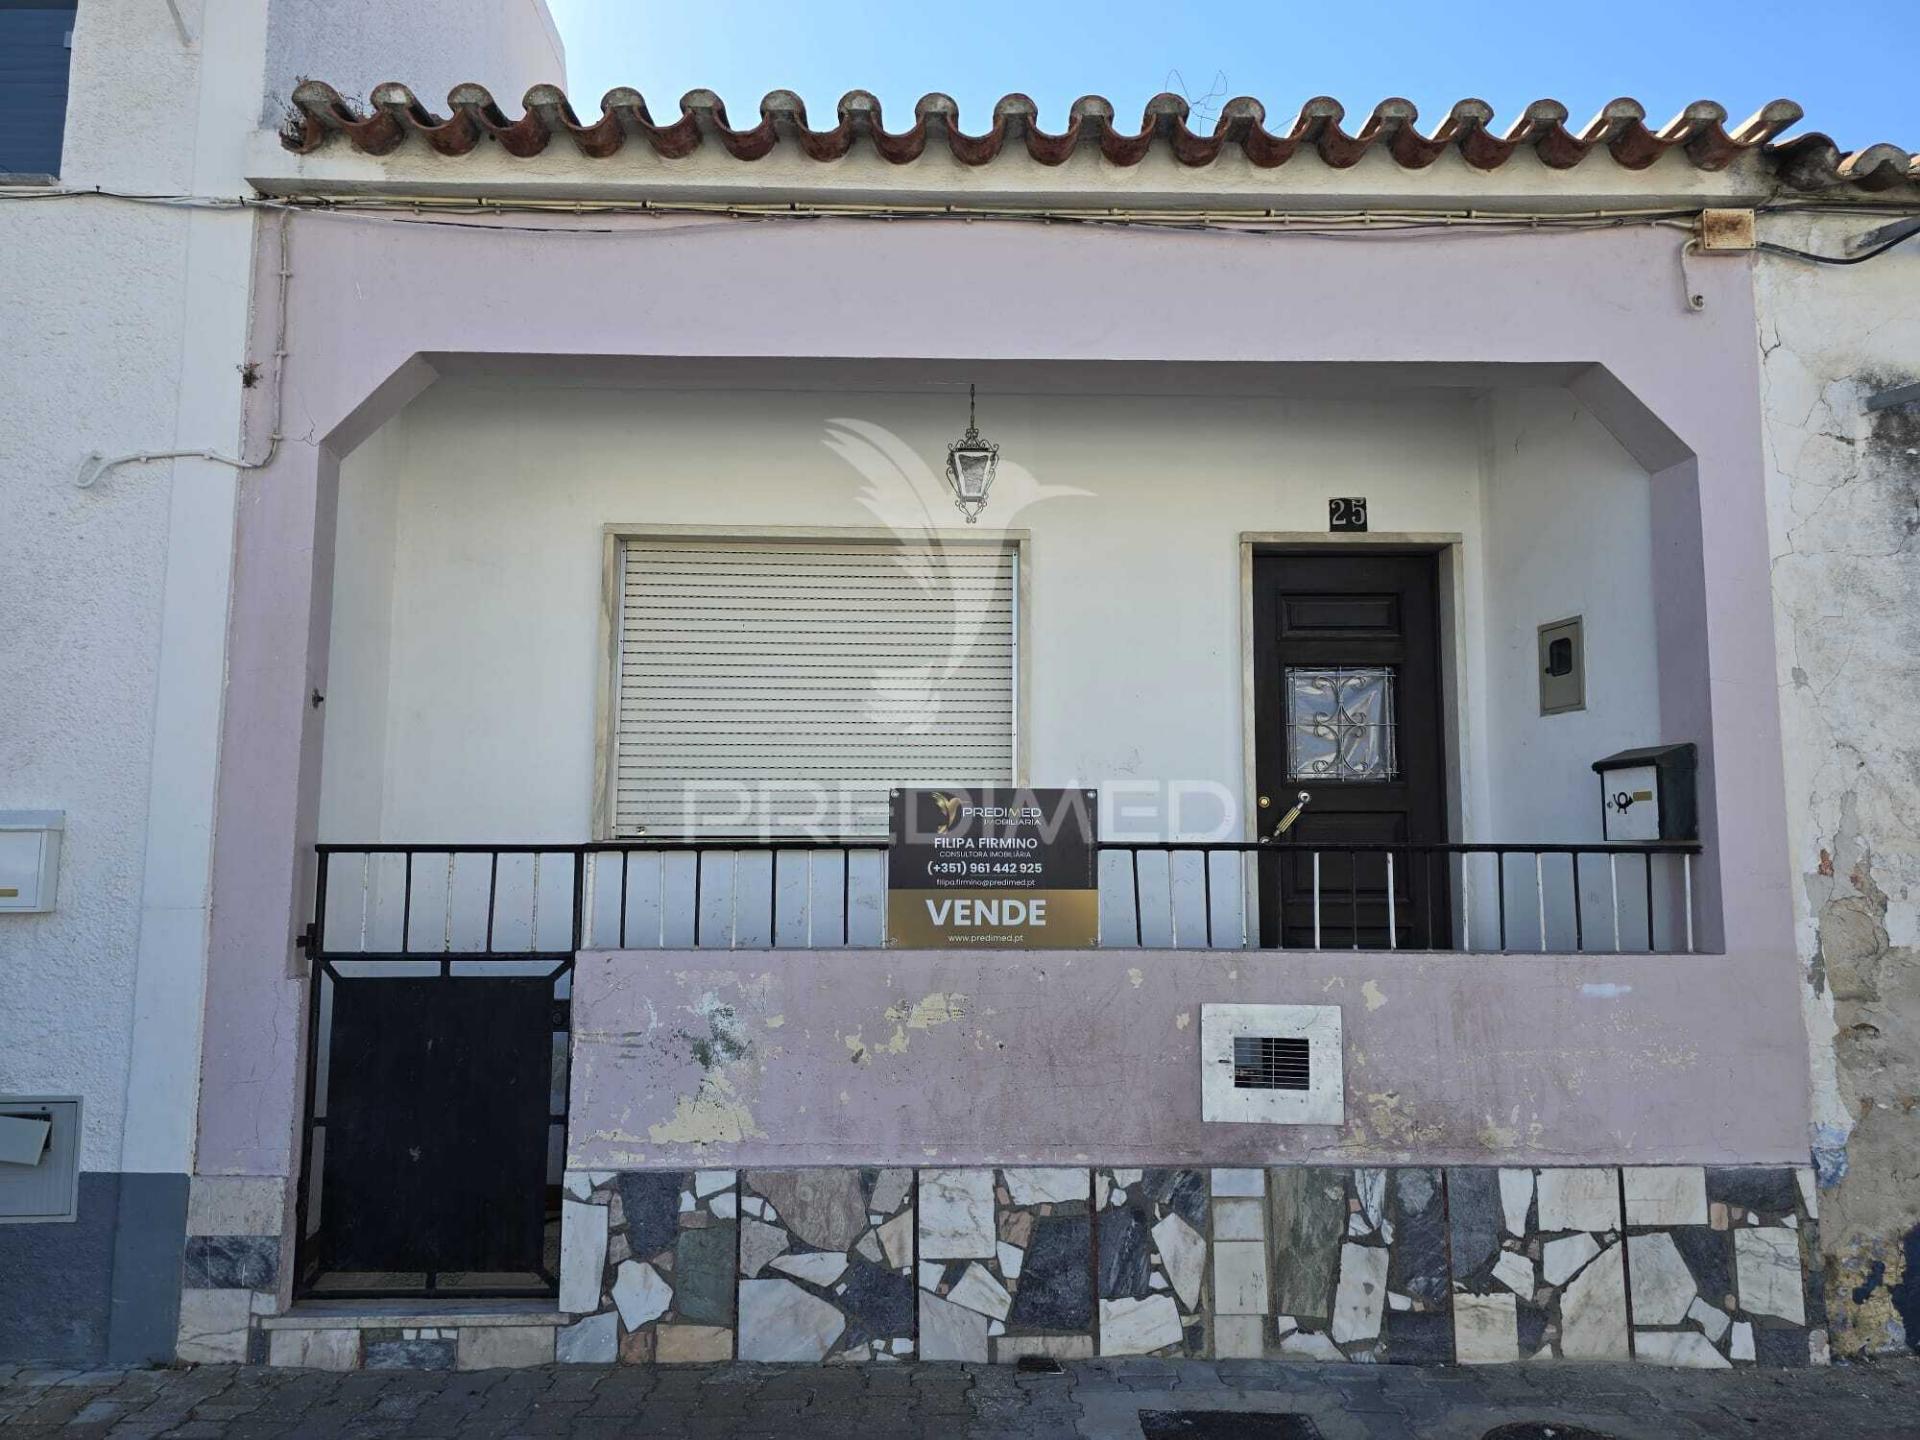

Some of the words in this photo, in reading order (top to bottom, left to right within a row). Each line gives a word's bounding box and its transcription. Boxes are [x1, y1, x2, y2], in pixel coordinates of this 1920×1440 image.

[1331, 499, 1366, 525] 25
[962, 807, 1042, 817] PREDIMED
[934, 837, 975, 849] FILIPA
[978, 837, 1038, 849] FIRMINO
[927, 861, 967, 875] (+351)
[970, 863, 990, 873] 961
[993, 863, 1017, 873] 442
[1019, 863, 1042, 873] 925
[936, 878, 1036, 887] filipa.firmino@predimed.pt
[925, 899, 1047, 926] VENDE
[947, 934, 1024, 943] www.predimed.pt
